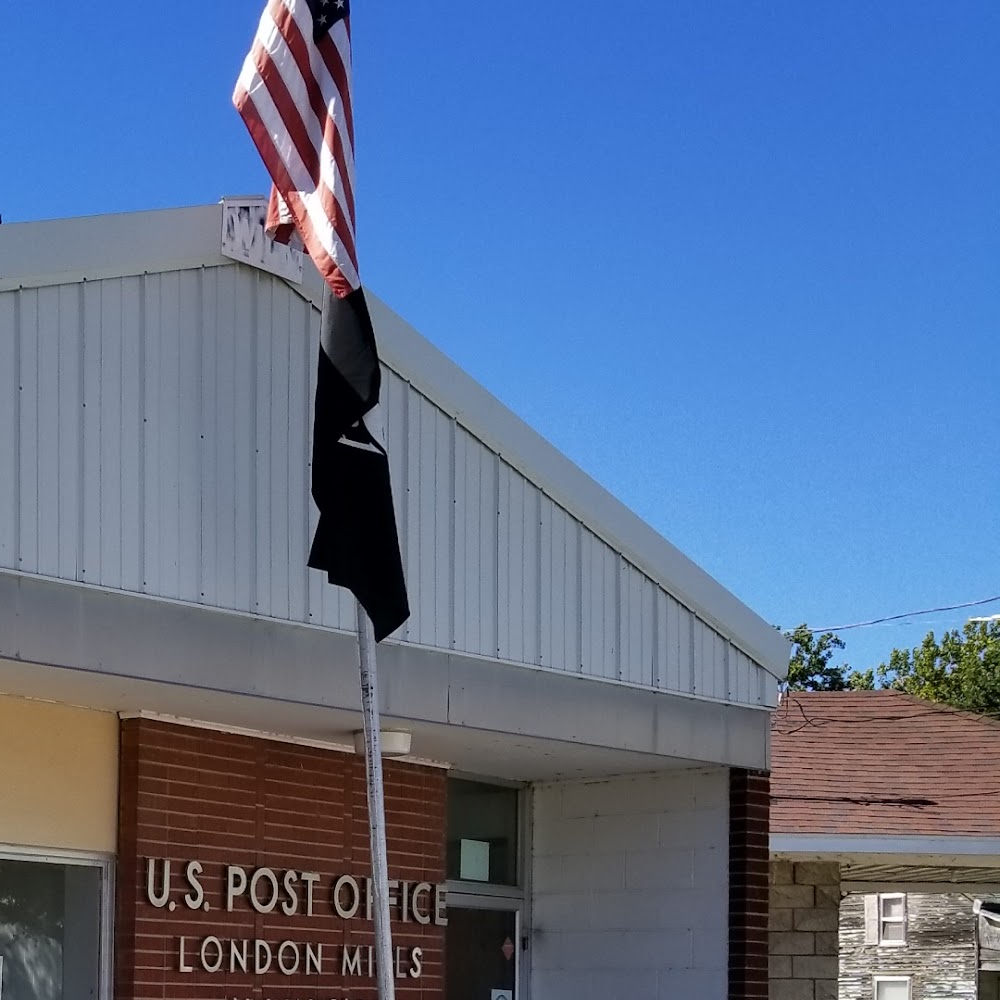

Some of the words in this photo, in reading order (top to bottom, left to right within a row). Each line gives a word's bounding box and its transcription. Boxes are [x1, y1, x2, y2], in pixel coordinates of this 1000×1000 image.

[147, 858, 210, 912] U.S.
[227, 865, 321, 917] POST
[179, 935, 322, 976] LONDON
[342, 945, 423, 979] MILS
